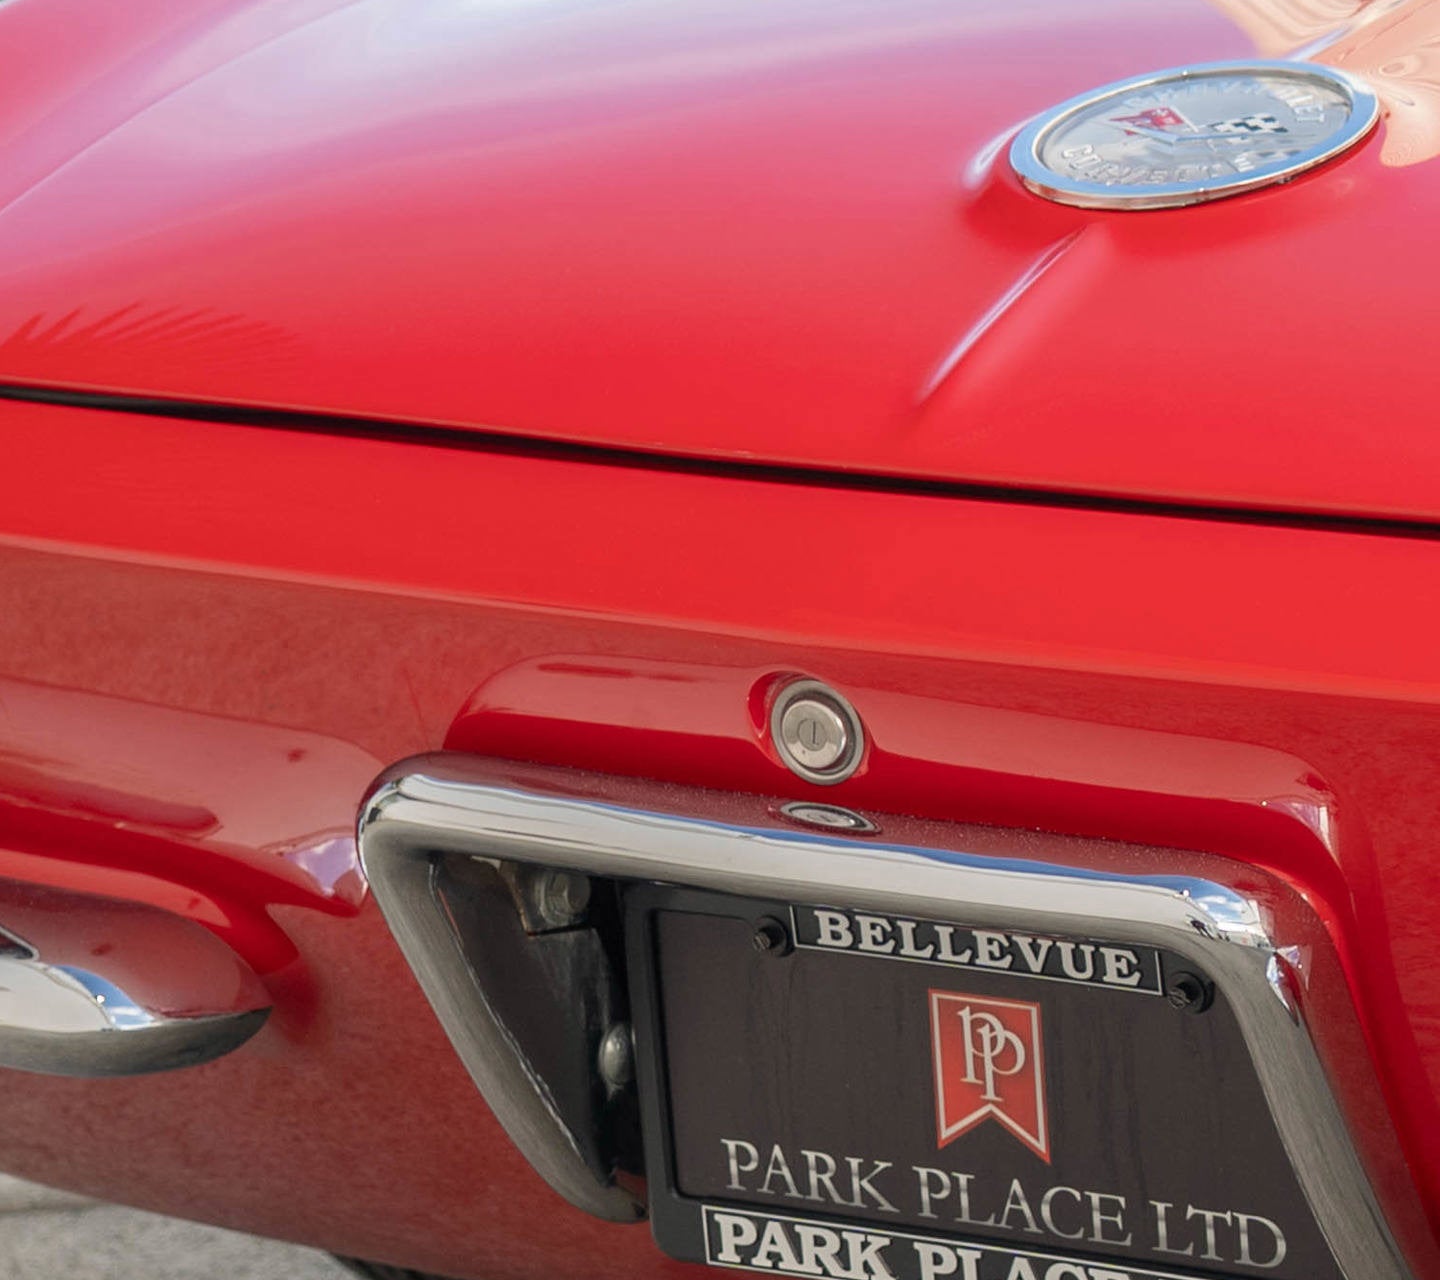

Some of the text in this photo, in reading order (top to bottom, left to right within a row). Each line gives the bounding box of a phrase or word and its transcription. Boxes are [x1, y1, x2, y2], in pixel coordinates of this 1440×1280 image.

[813, 909, 1142, 987] BELLEVUE
[720, 1138, 1287, 1269] PARK PLACE LTD
